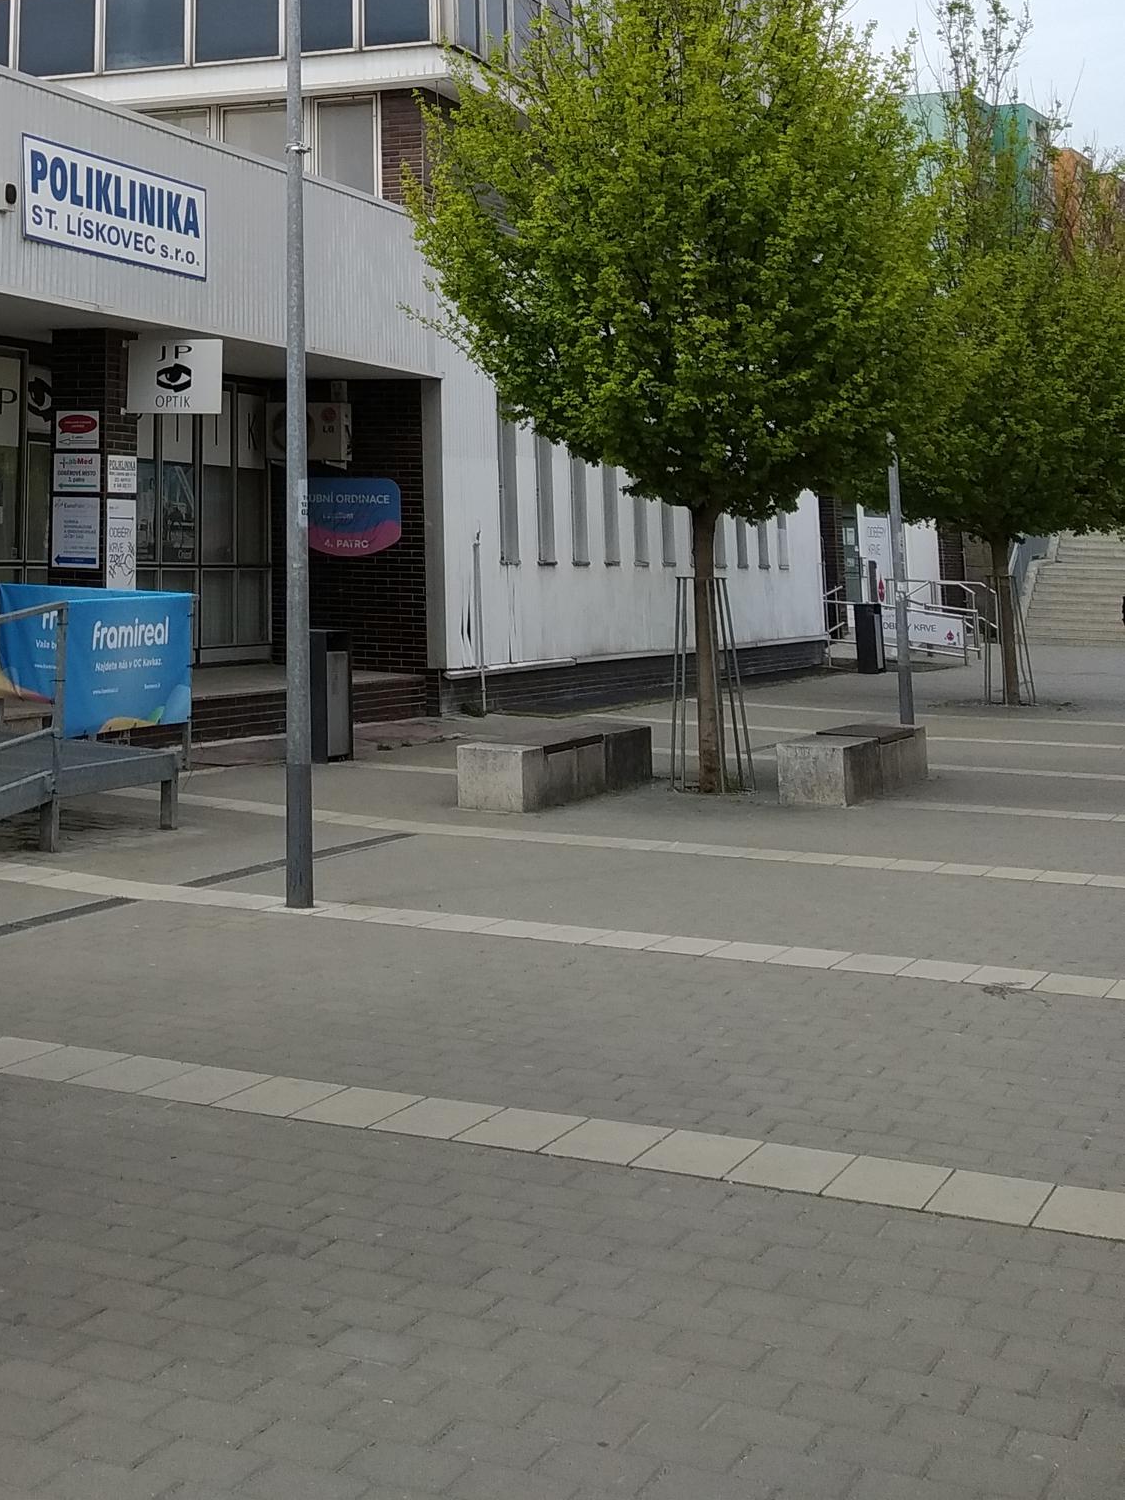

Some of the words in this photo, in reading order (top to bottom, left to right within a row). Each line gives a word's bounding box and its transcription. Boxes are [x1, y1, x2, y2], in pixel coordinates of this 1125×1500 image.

[30, 149, 200, 239] POLIKLINIKA
[32, 205, 58, 231] ST.
[66, 211, 155, 255] LÍSKOVEC
[160, 244, 200, 266] s.r.o.
[155, 395, 191, 408] OPTIK
[308, 491, 334, 504] UBNÍ
[336, 494, 391, 505] ORDINACE
[92, 616, 169, 651] framireal
